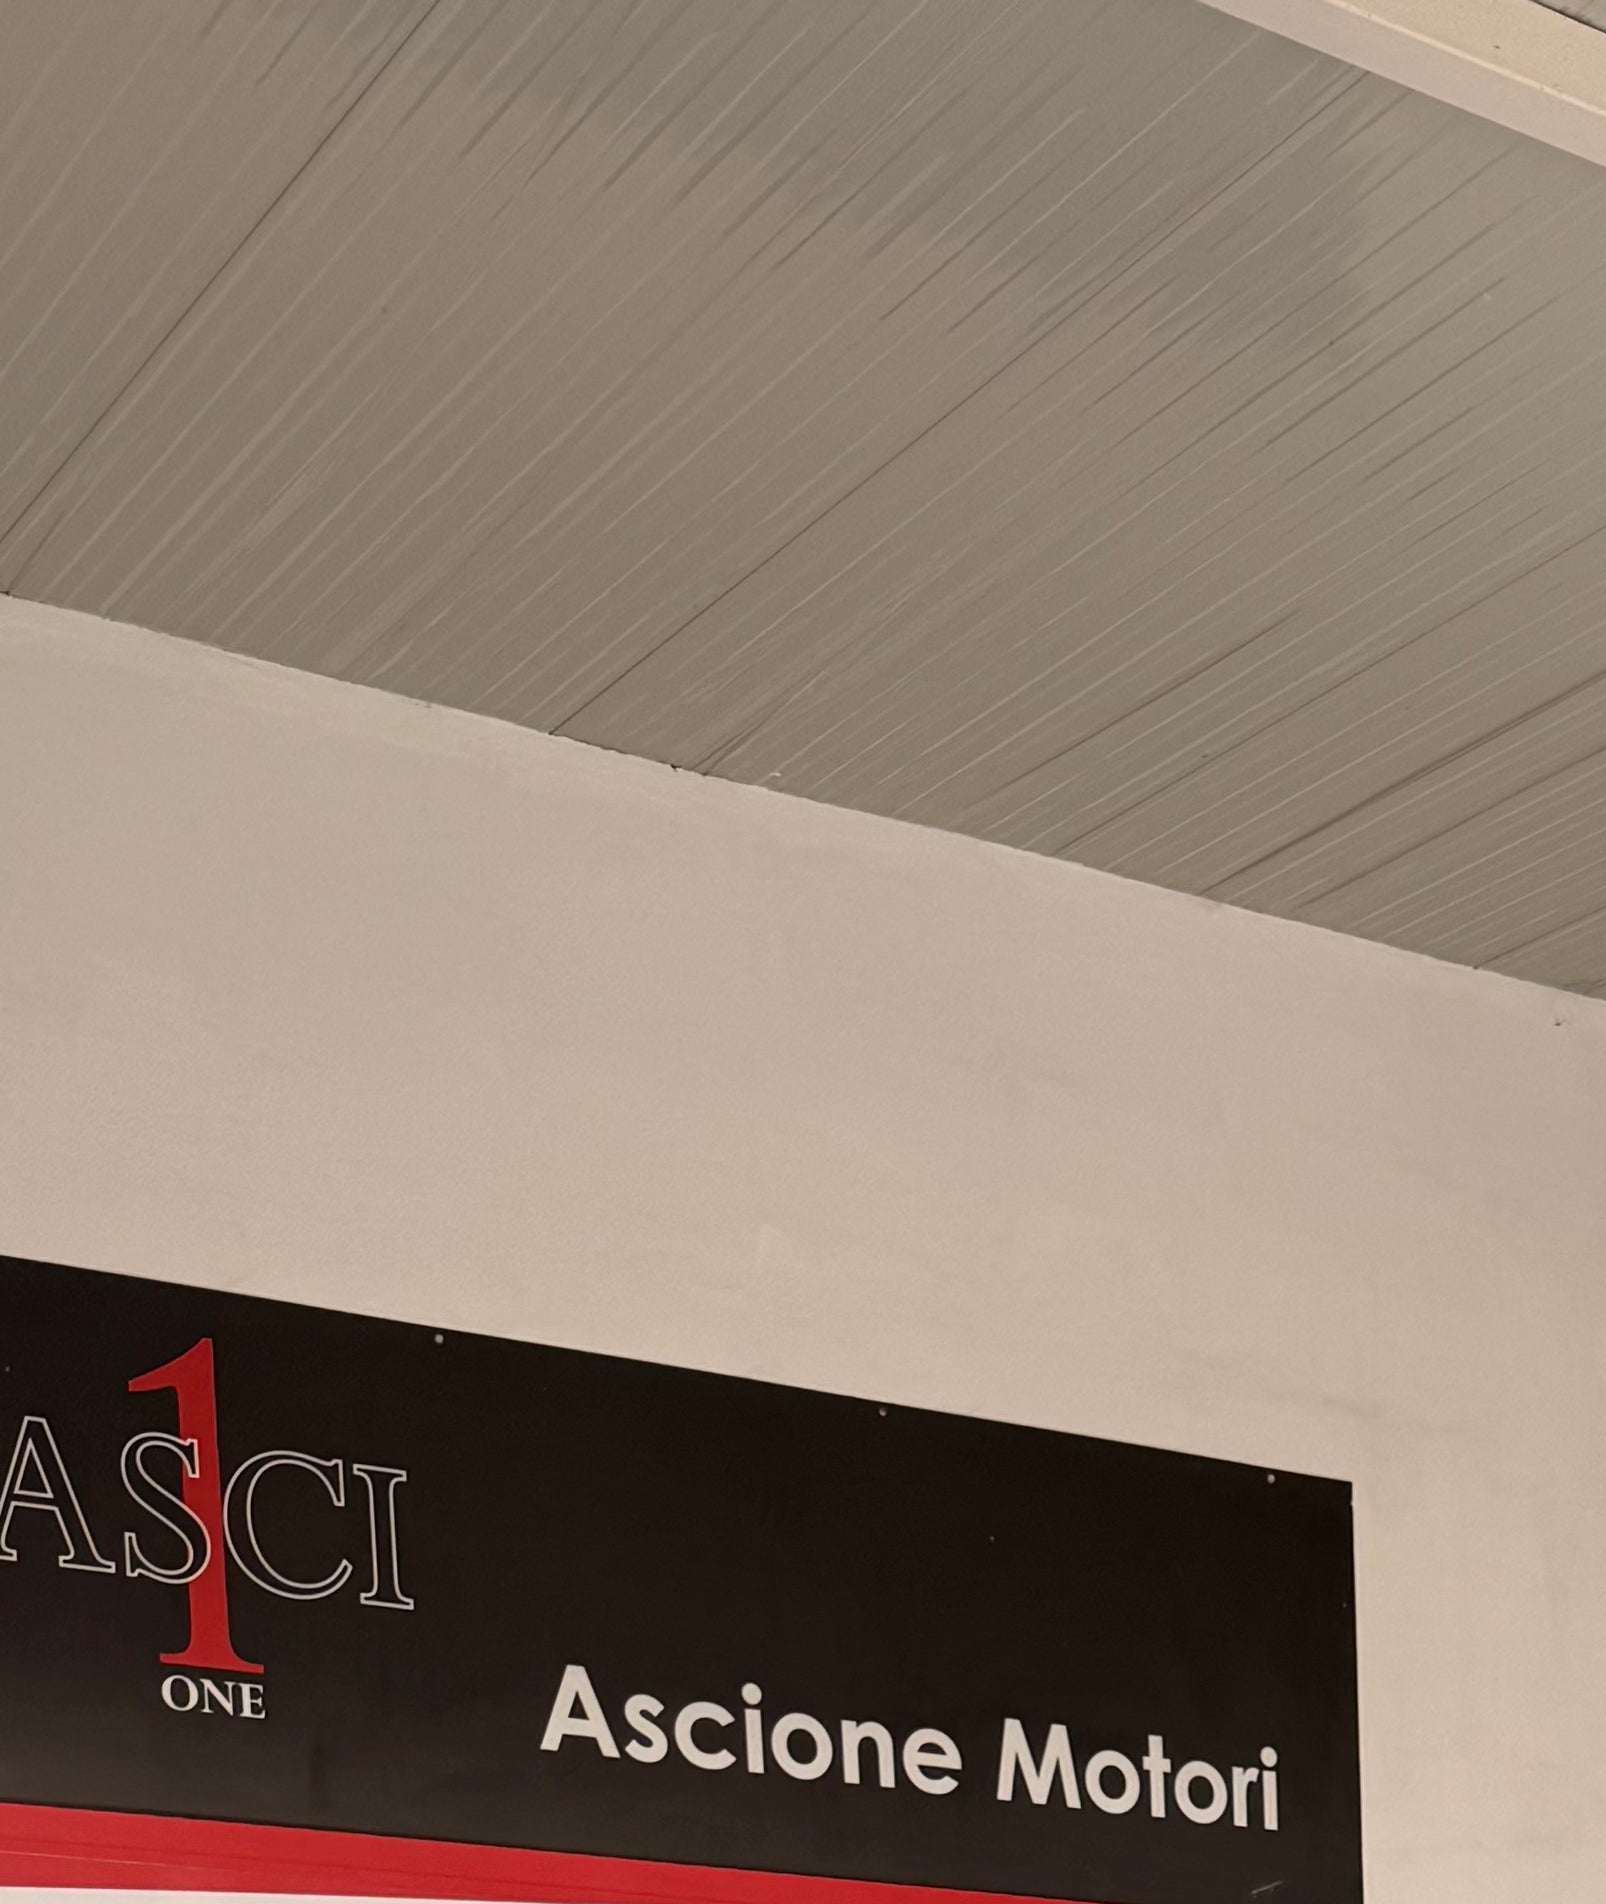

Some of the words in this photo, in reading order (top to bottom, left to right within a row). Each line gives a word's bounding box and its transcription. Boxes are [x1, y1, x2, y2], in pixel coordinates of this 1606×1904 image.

[0, 1415, 414, 1610] ASCI
[161, 1674, 266, 1720] ONE
[540, 1664, 963, 1795] Ascione
[996, 1717, 1280, 1831] Motori
